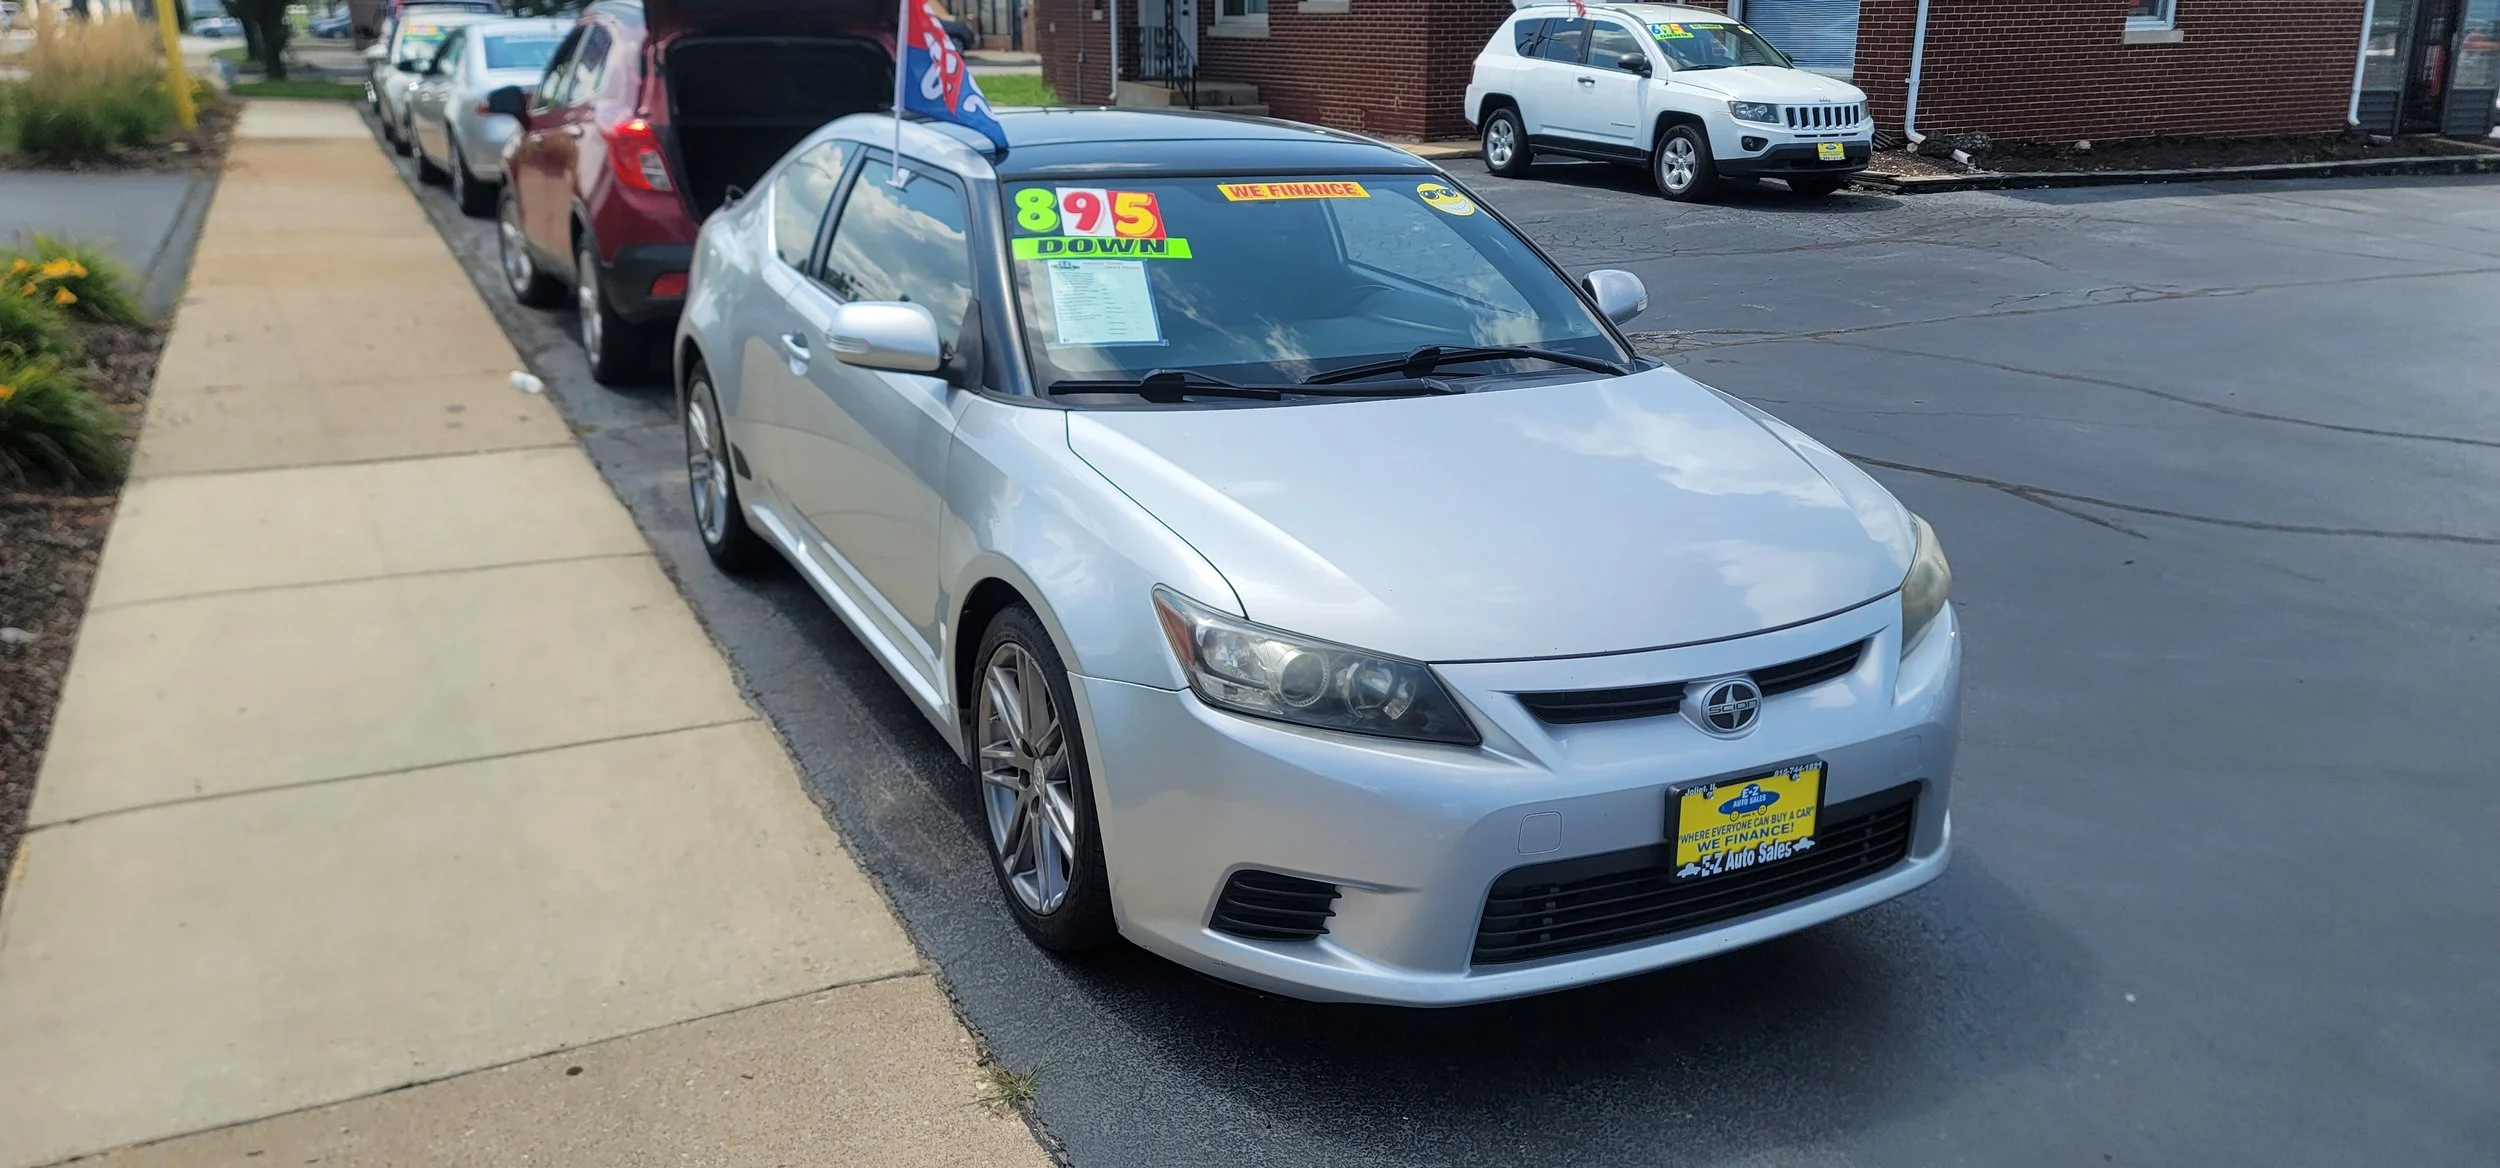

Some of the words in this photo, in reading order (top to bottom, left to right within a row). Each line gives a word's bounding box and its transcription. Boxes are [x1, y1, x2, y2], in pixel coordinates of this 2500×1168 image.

[1229, 185, 1265, 198] WE
[1267, 183, 1359, 197] FINANCE
[1015, 188, 1157, 237] 895
[1037, 239, 1168, 255] DOWN
[1709, 699, 1757, 714] SCION
[1742, 786, 1759, 798] E-Z
[1733, 798, 1748, 808] AUTO
[1749, 794, 1766, 804] SALES
[1712, 820, 1751, 837] EVERYONE
[1754, 815, 1768, 828] CAN
[1771, 812, 1786, 824] BUY
[1789, 810, 1794, 820] A
[1697, 839, 1720, 852] WE
[1725, 822, 1794, 846] FINANCE!
[1702, 853, 1723, 877] E-Z
[1725, 848, 1755, 871] Auto
[1758, 840, 1792, 864] Sales
